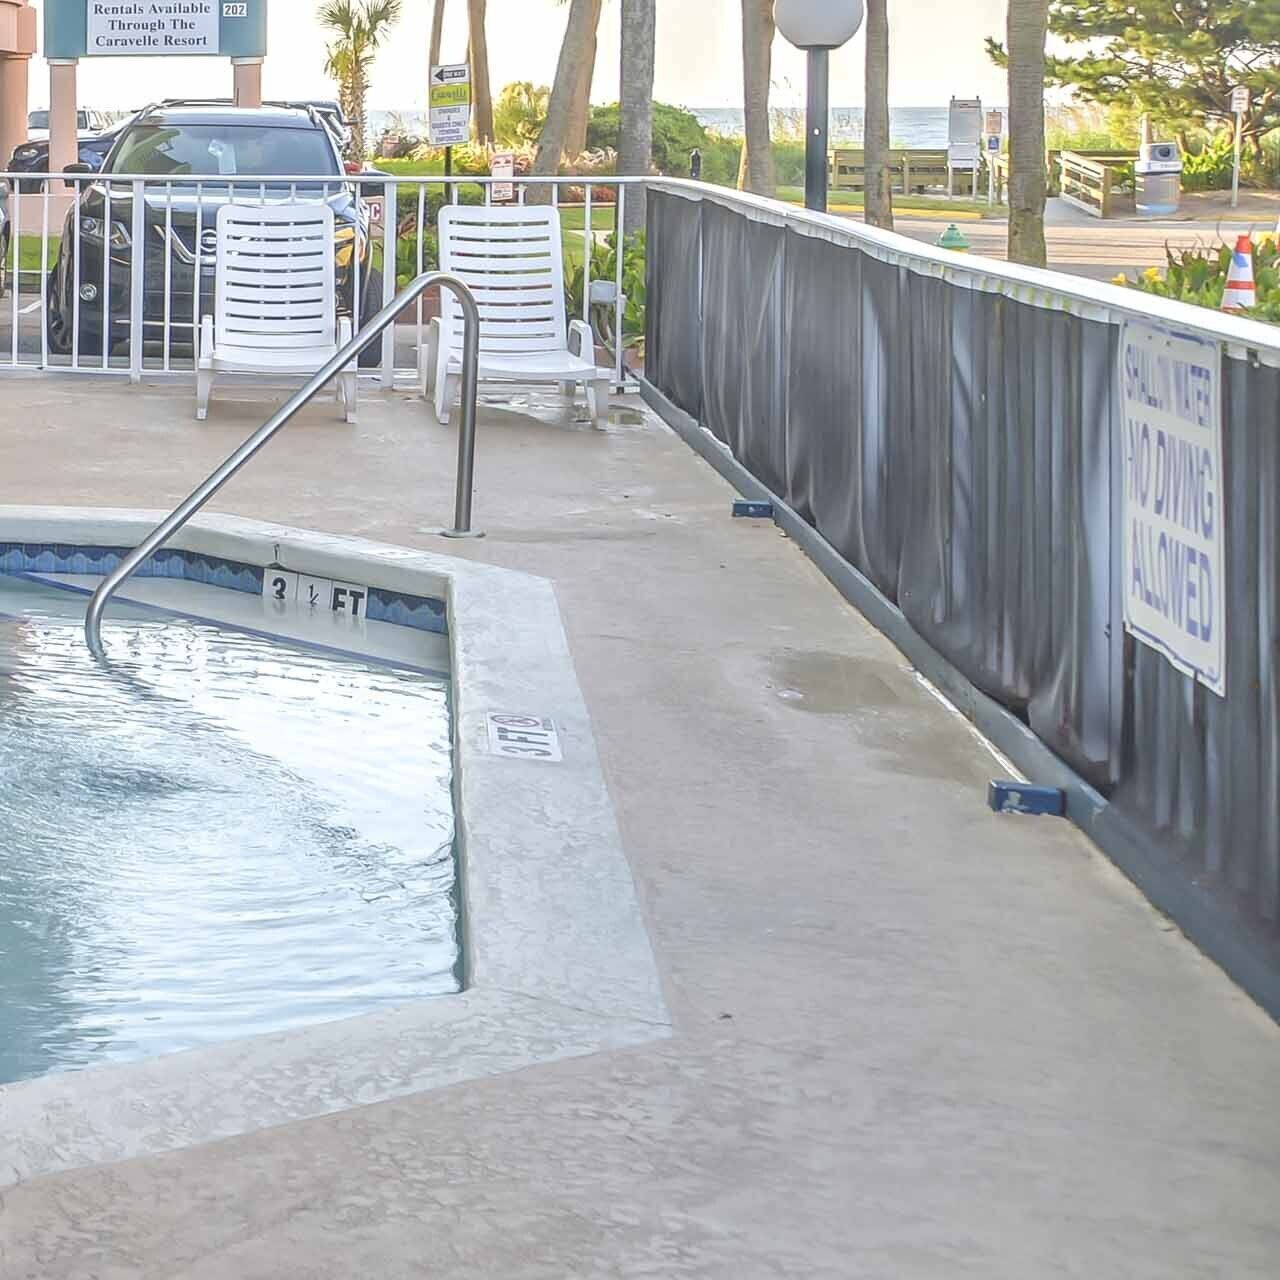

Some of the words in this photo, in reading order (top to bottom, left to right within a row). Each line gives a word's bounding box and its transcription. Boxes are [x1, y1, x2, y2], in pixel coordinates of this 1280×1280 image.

[93, 2, 145, 16] Rentals
[148, 2, 211, 16] Available
[224, 3, 246, 16] 202
[107, 18, 165, 32] Through
[169, 18, 196, 31] The
[95, 34, 160, 48] Caravelle
[163, 33, 208, 47] Resort
[1128, 418, 1151, 508] NO
[1154, 429, 1214, 541] DIVING
[1132, 517, 1212, 642] ALLOWED
[271, 577, 288, 600] 3
[332, 587, 365, 616] FT
